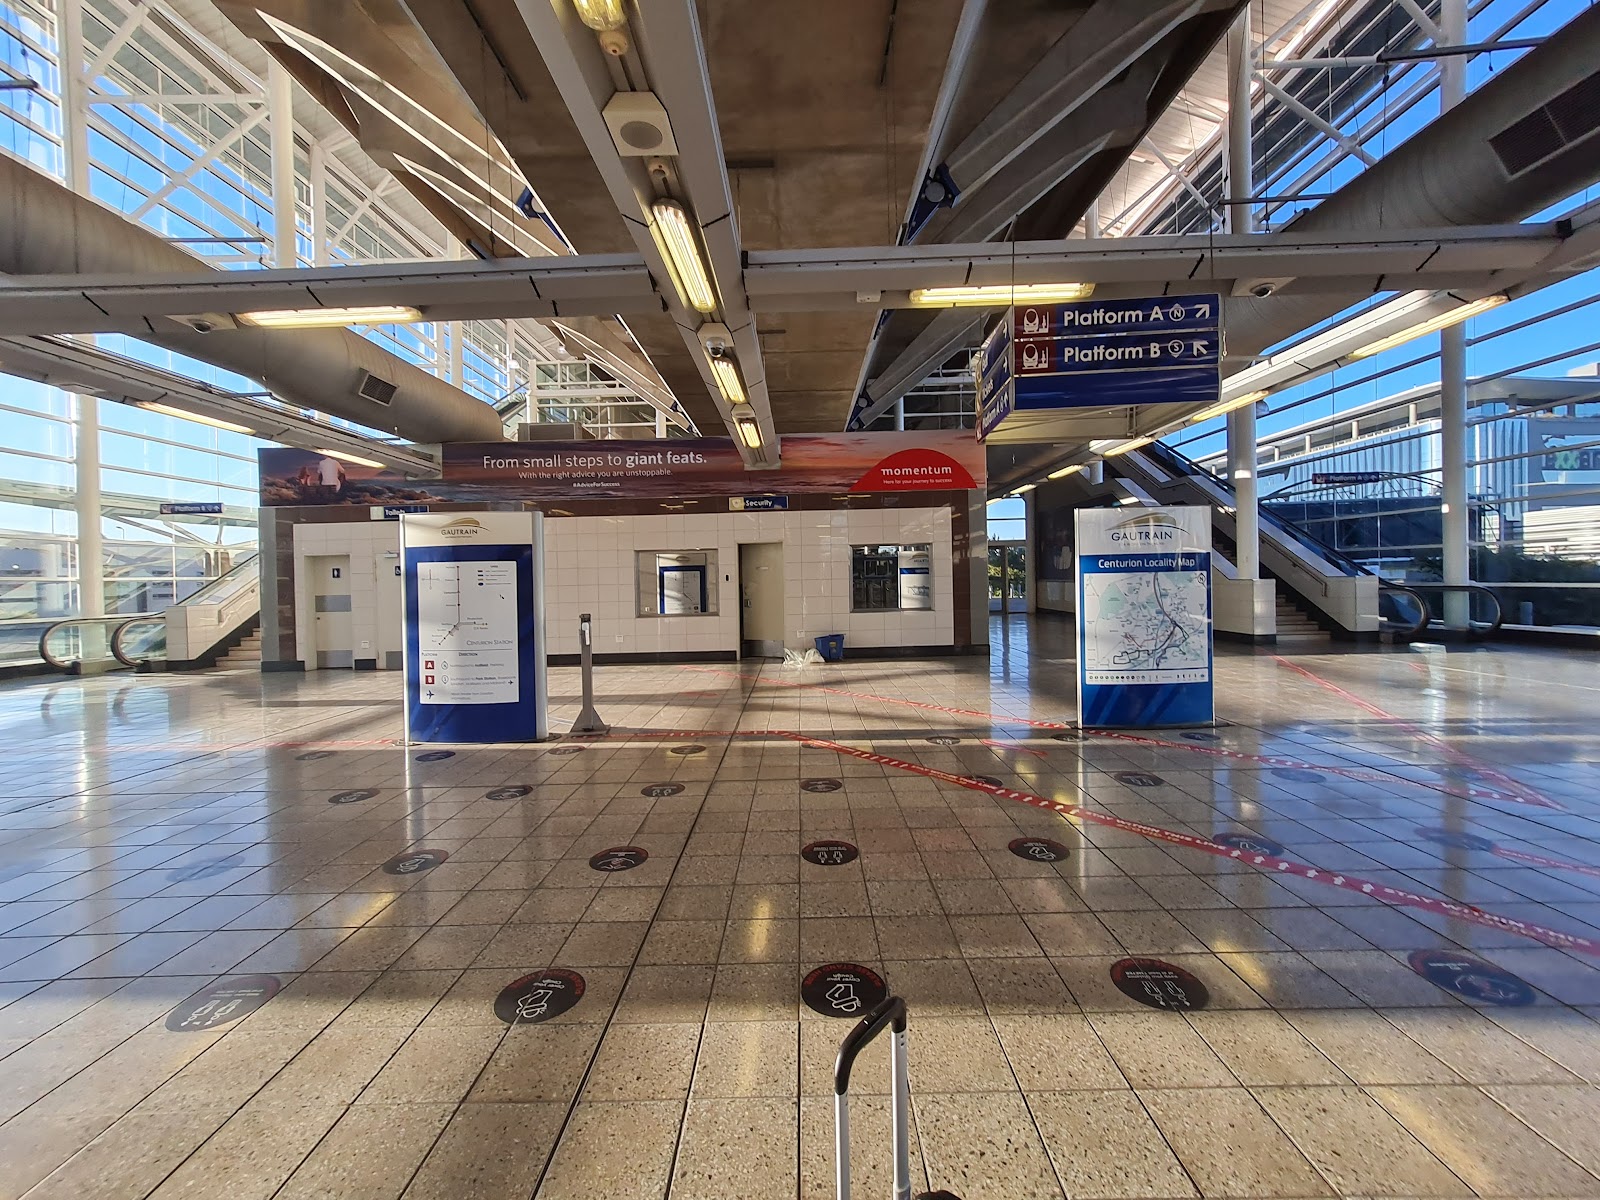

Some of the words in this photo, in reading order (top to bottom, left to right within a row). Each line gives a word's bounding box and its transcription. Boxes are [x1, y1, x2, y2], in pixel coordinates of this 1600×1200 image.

[1064, 309, 1143, 327] Platform
[1150, 308, 1164, 321] A
[1064, 345, 1143, 363] Platform
[1150, 346, 1160, 358] B
[483, 456, 519, 468] From
[523, 454, 561, 468] small
[565, 454, 604, 469] steps
[608, 454, 622, 466] to
[626, 451, 662, 468] giant
[666, 450, 708, 464] feats.
[518, 471, 536, 479] With
[552, 470, 570, 480] right
[572, 470, 596, 478] advice
[597, 472, 610, 480] you
[626, 468, 673, 478] unstoppable.
[880, 466, 952, 476] momentum
[746, 499, 772, 508] Security
[1112, 531, 1172, 541] GAUTRAIN
[1098, 558, 1142, 568] Centurion
[1144, 558, 1177, 570] Locality
[1178, 558, 1196, 568] Map
[1086, 810, 1112, 820] STAY
[1116, 818, 1160, 833] WITHIN
[1196, 838, 1228, 850] LINE
